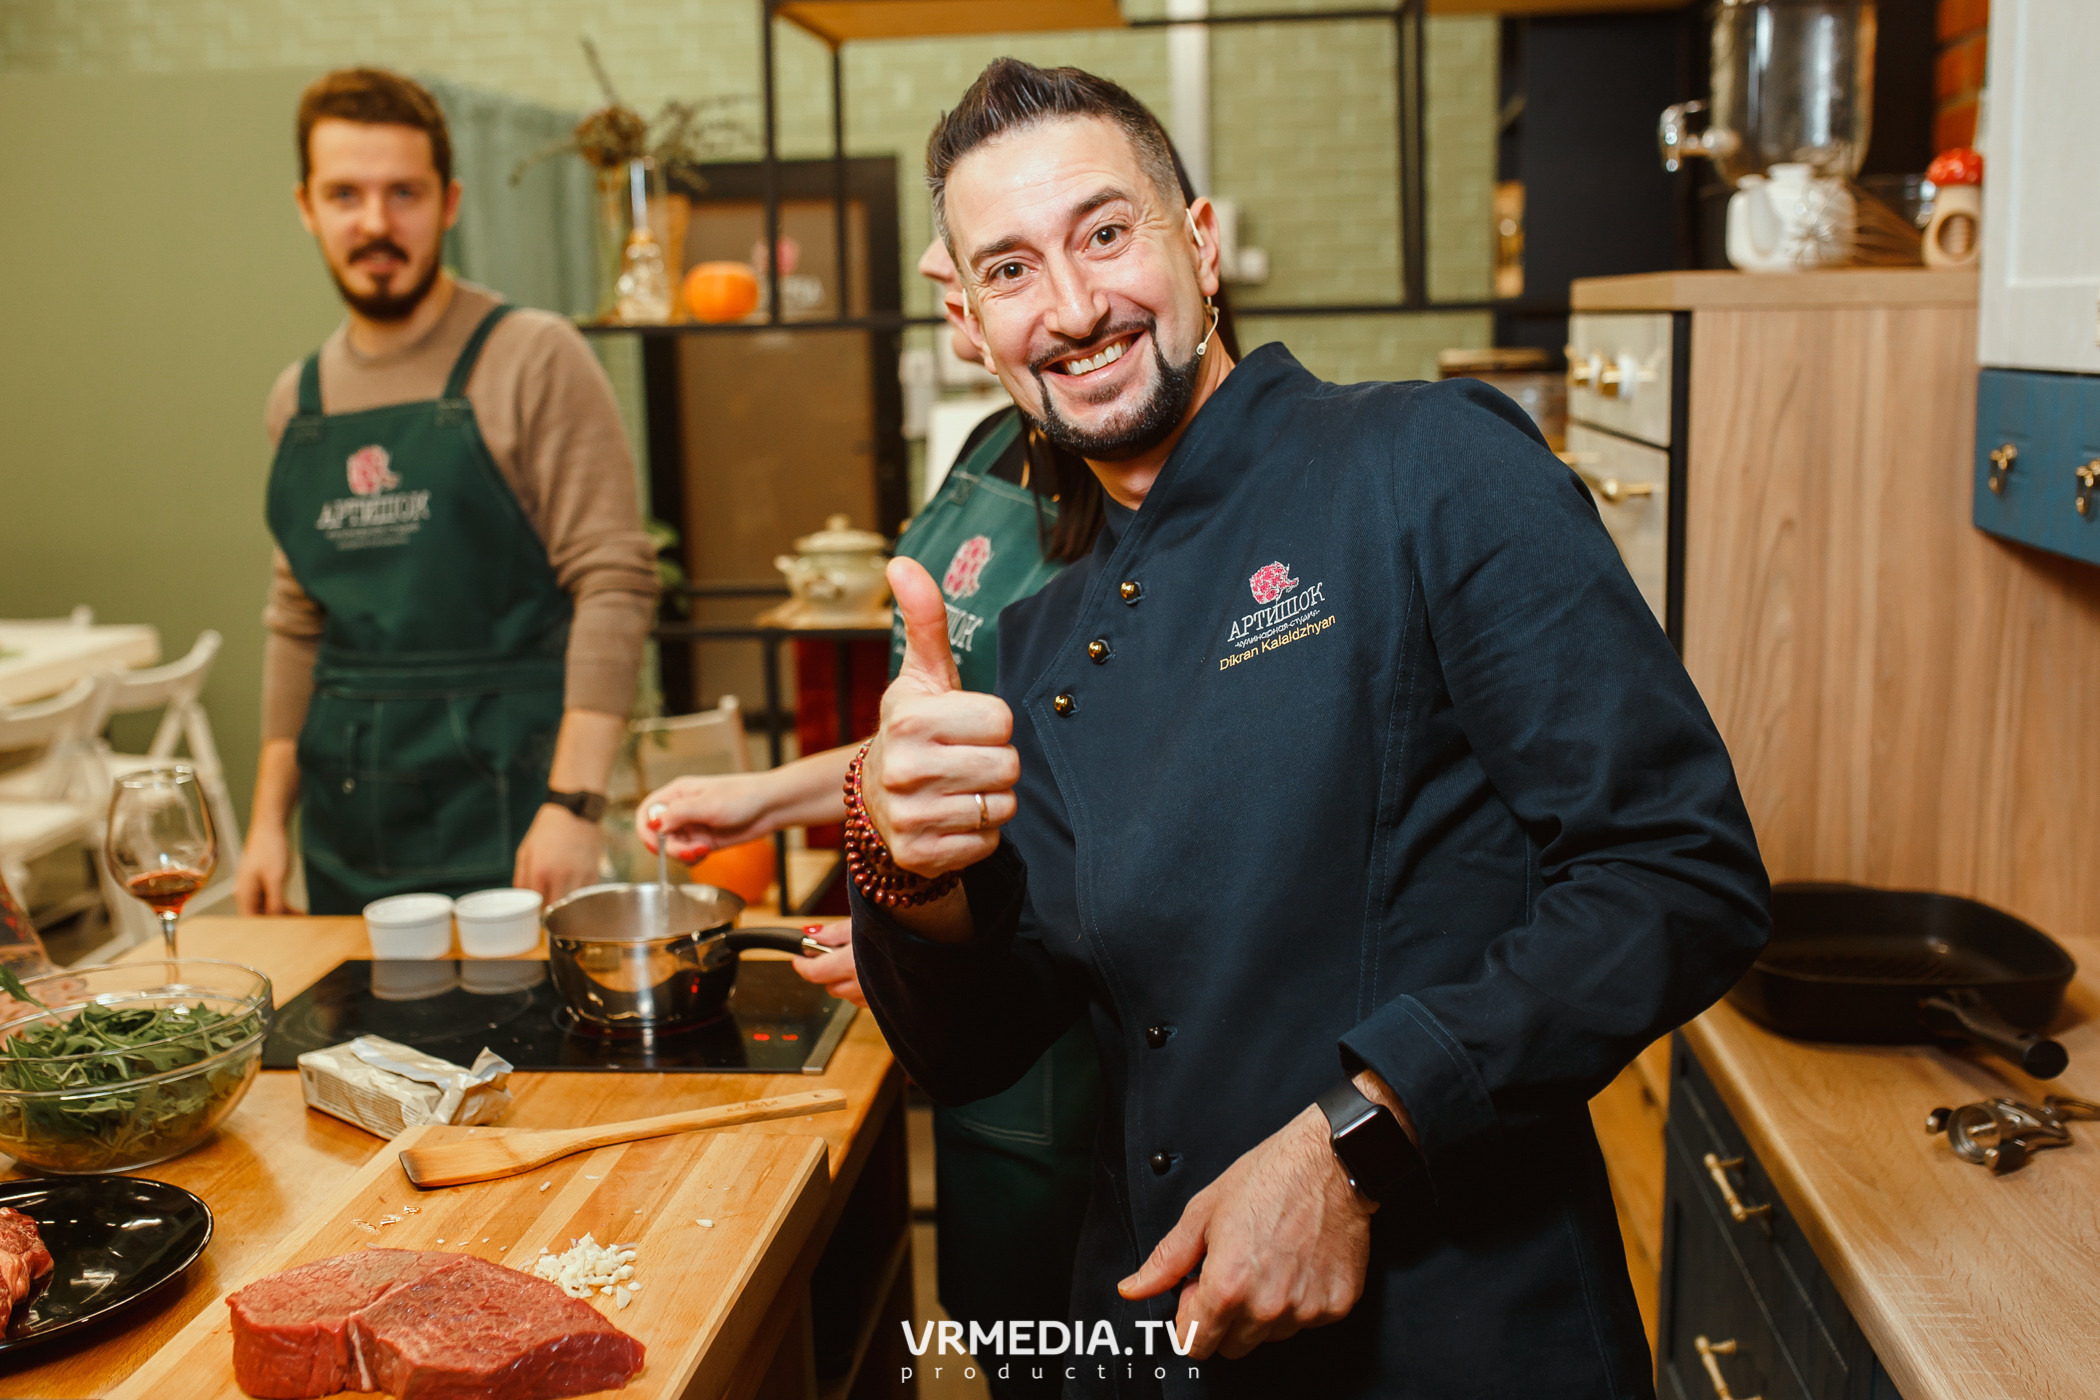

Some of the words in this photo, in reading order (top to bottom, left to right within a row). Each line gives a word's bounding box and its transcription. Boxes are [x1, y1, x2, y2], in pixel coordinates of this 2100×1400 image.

[1227, 582, 1325, 642] АРТИШОК
[1219, 647, 1259, 671] Dikran
[1261, 615, 1336, 653] Kalaldzhyan
